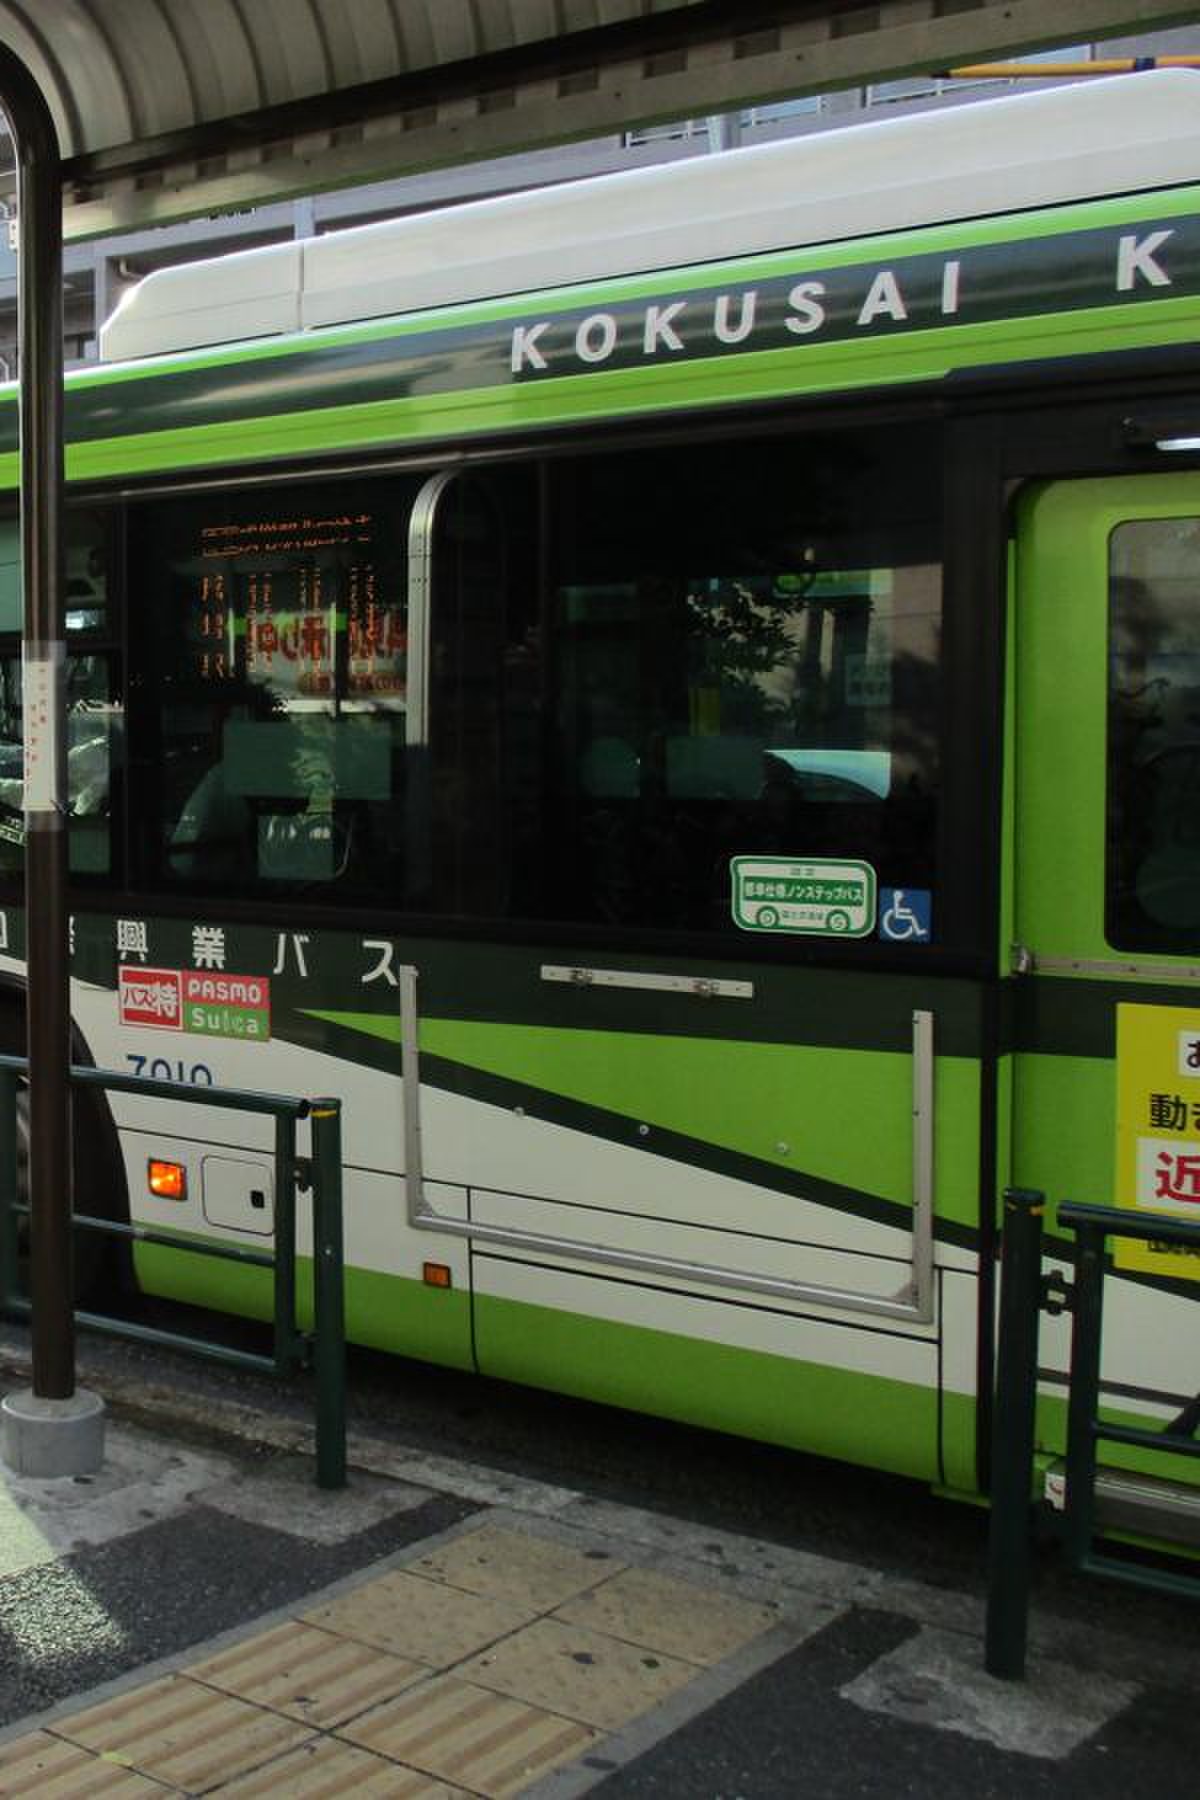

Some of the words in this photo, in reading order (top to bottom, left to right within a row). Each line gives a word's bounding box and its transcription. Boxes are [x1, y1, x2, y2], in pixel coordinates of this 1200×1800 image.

[511, 261, 960, 373] KOKUSAI
[1115, 230, 1176, 291] K
[188, 979, 261, 1004] PASMO
[191, 1007, 259, 1034] Suica
[1150, 1093, 1200, 1132] 動
